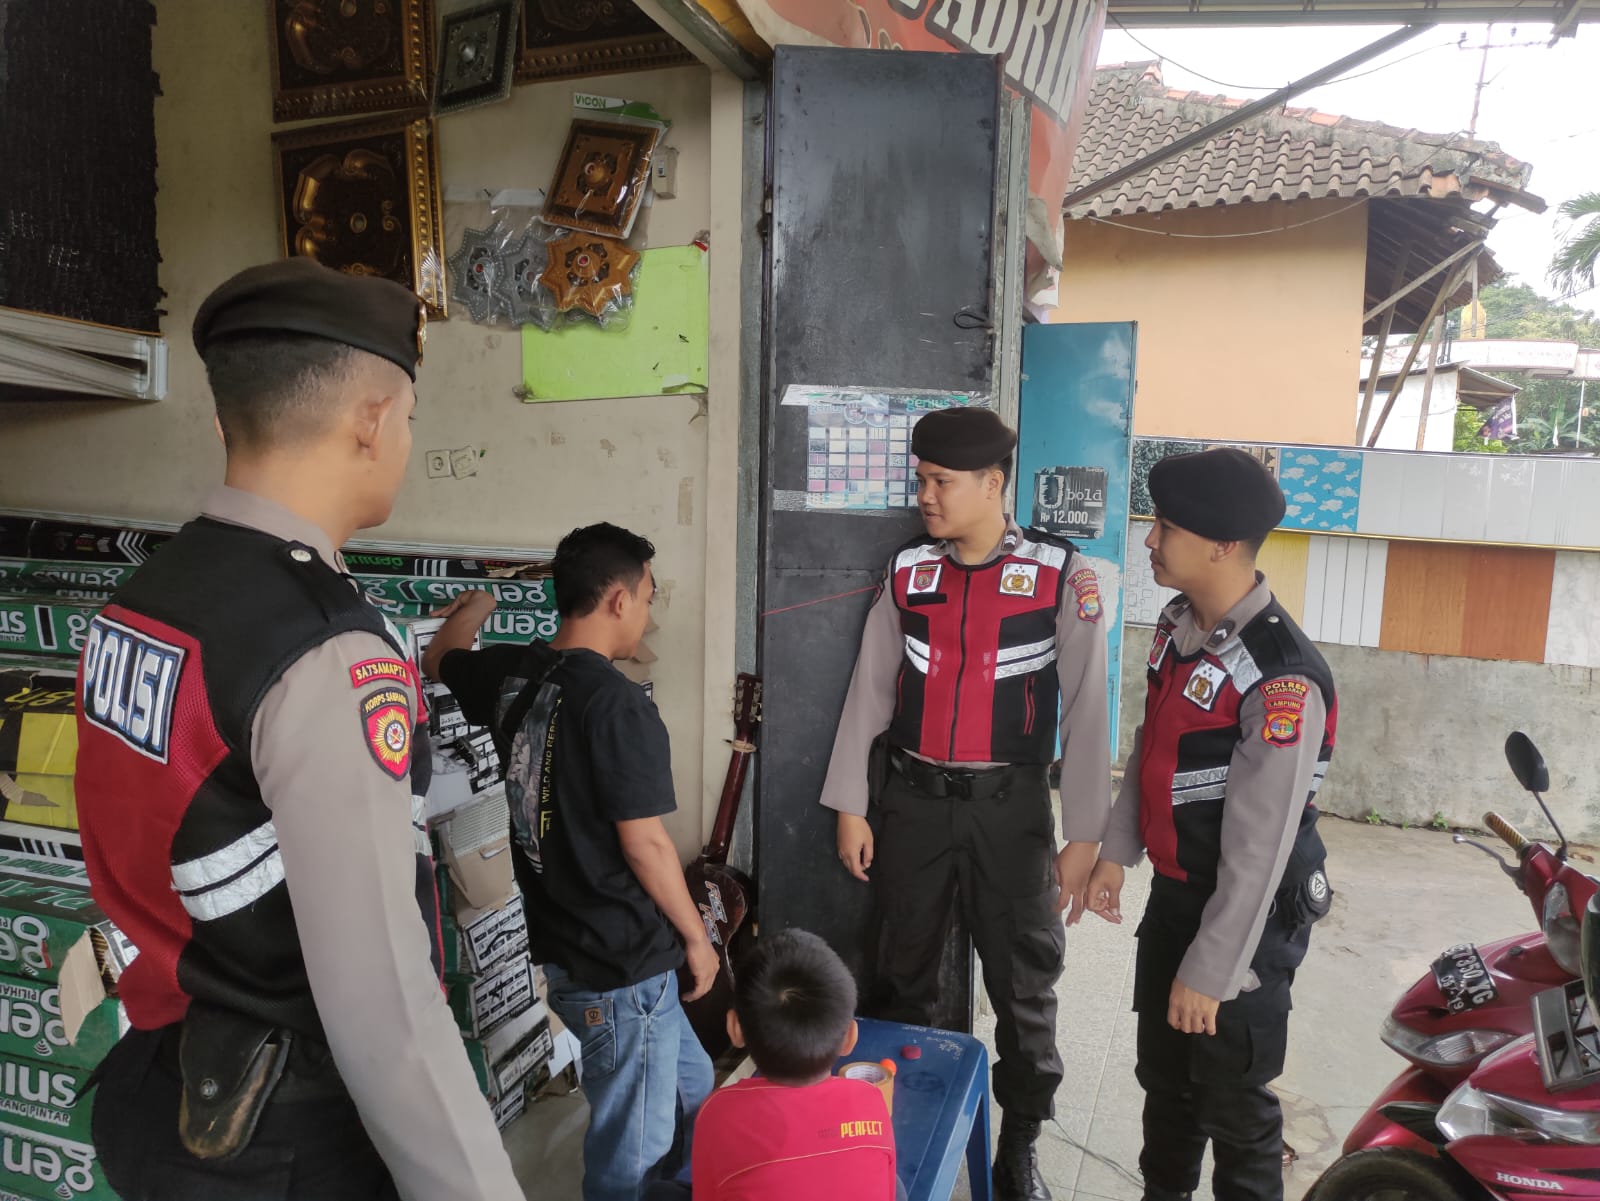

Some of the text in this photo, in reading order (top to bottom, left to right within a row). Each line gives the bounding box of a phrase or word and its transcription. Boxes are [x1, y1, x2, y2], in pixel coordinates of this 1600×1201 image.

[575, 95, 607, 109] VICON
[906, 396, 950, 412] genius
[1066, 489, 1103, 501] bold
[1040, 510, 1088, 524] Rp 12.000
[484, 608, 558, 636] geni
[355, 662, 407, 680] SATSAMAPTA
[84, 625, 174, 747] POLISI
[1265, 681, 1307, 692] POLRES
[364, 693, 386, 713] KORPS
[0, 984, 38, 1001] PILIHA
[28, 1104, 71, 1124] PINTAR
[840, 1120, 883, 1139] PERFECT
[1496, 1171, 1564, 1190] HONDA
